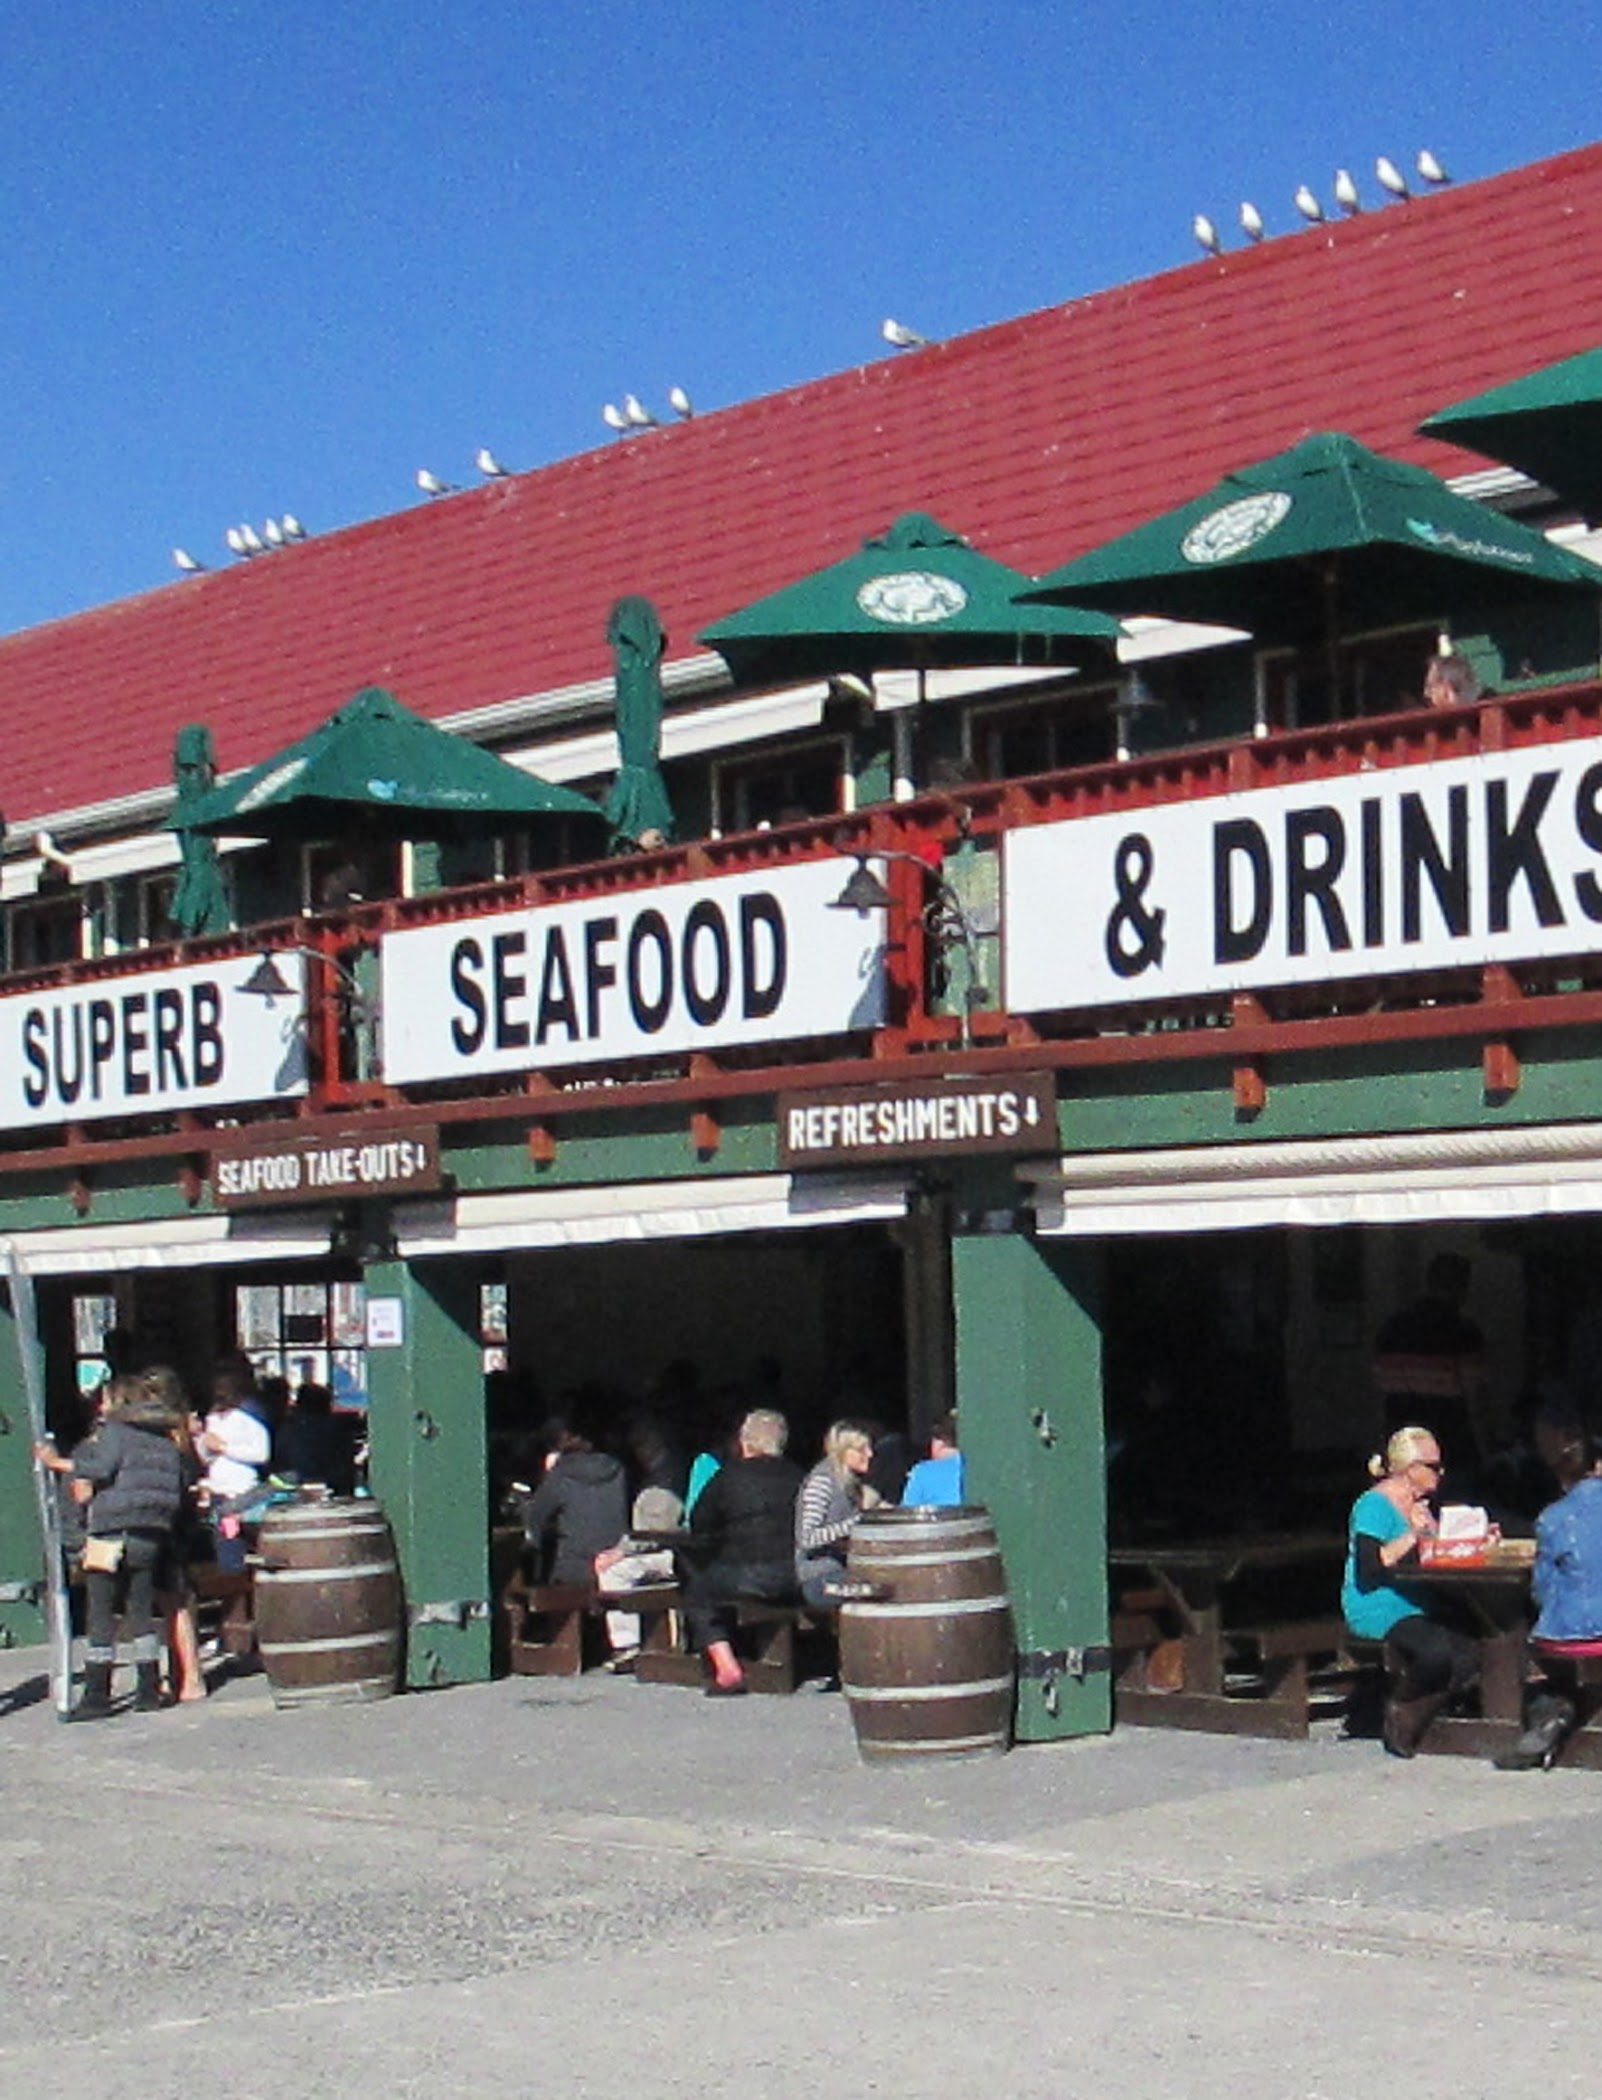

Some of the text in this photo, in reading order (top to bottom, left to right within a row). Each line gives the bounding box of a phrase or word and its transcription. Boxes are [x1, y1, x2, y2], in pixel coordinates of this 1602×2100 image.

[1105, 833, 1166, 978] &
[450, 892, 787, 1057] SEAFOOD
[23, 981, 224, 1108] SUPERB
[218, 1141, 415, 1194] SEAFOOD TAKE-OUTS
[789, 1091, 1019, 1150] REFRESHMENTS
